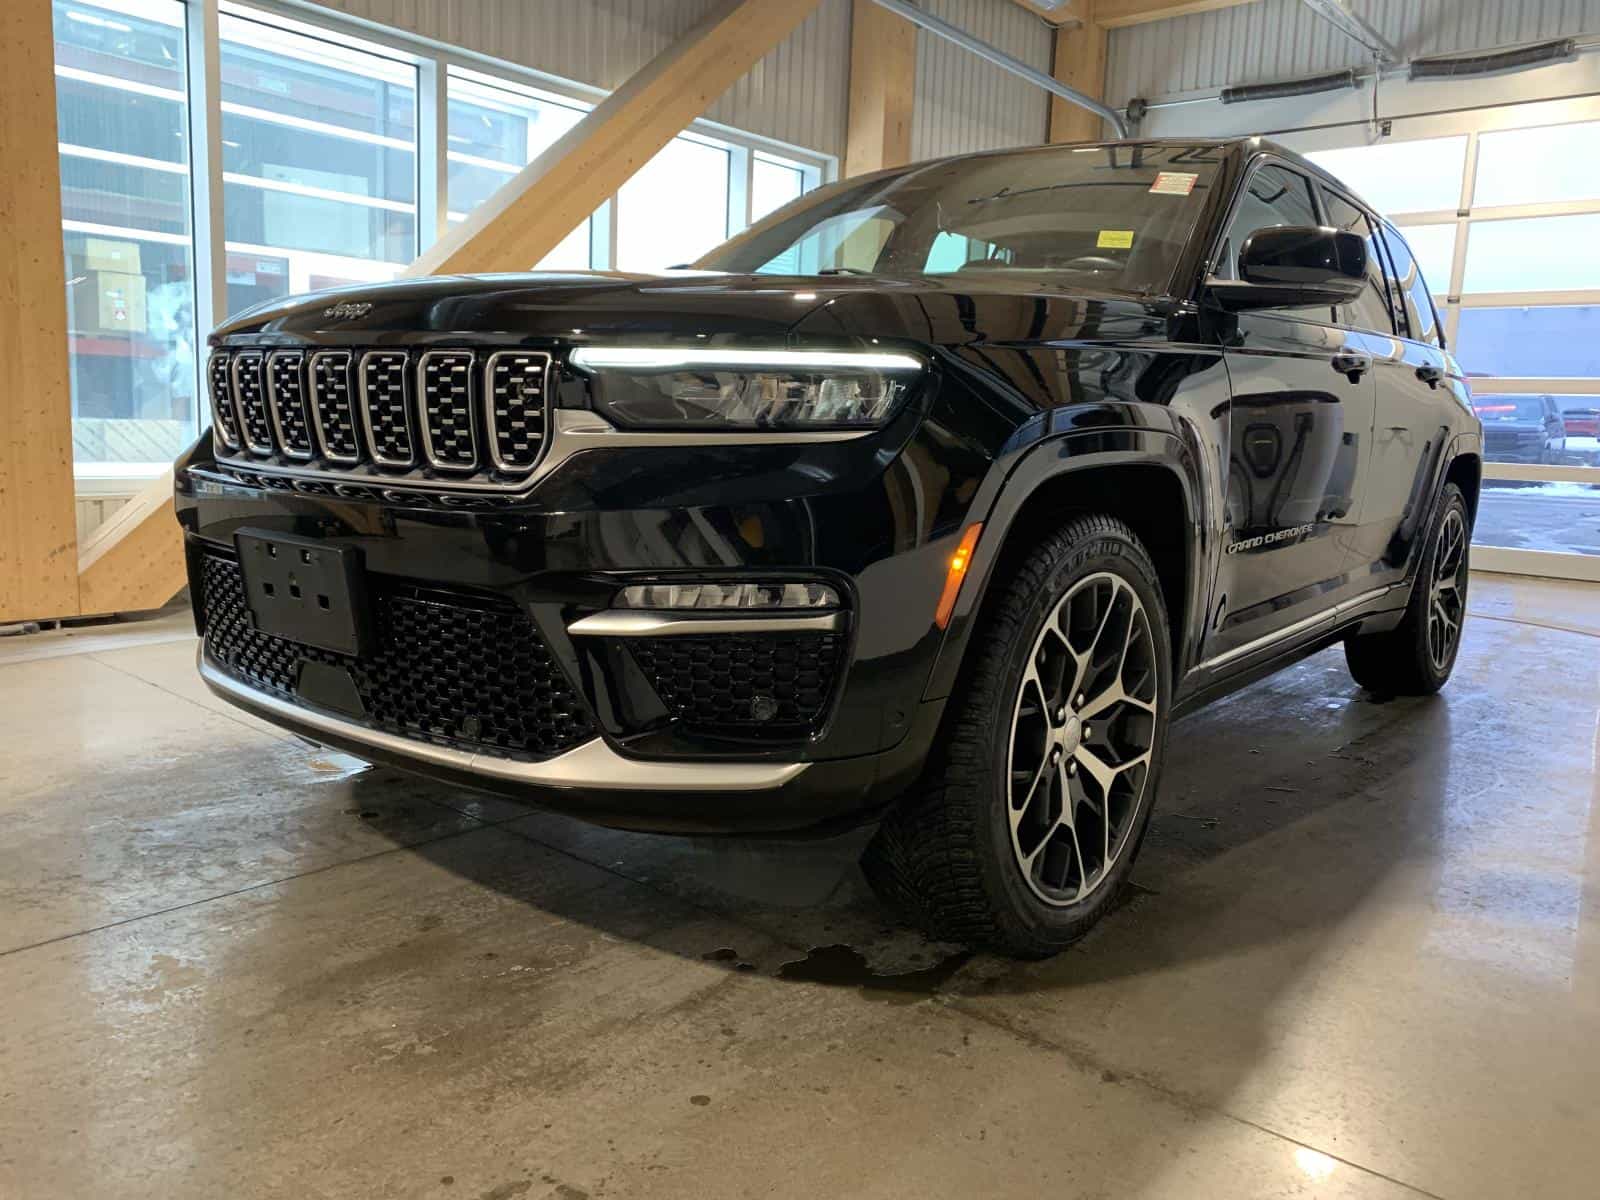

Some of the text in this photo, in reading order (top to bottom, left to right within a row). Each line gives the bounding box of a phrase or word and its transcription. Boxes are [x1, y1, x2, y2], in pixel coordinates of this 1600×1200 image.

[323, 301, 373, 319] Jeep
[1227, 523, 1313, 554] GRAND CHEROKEE
